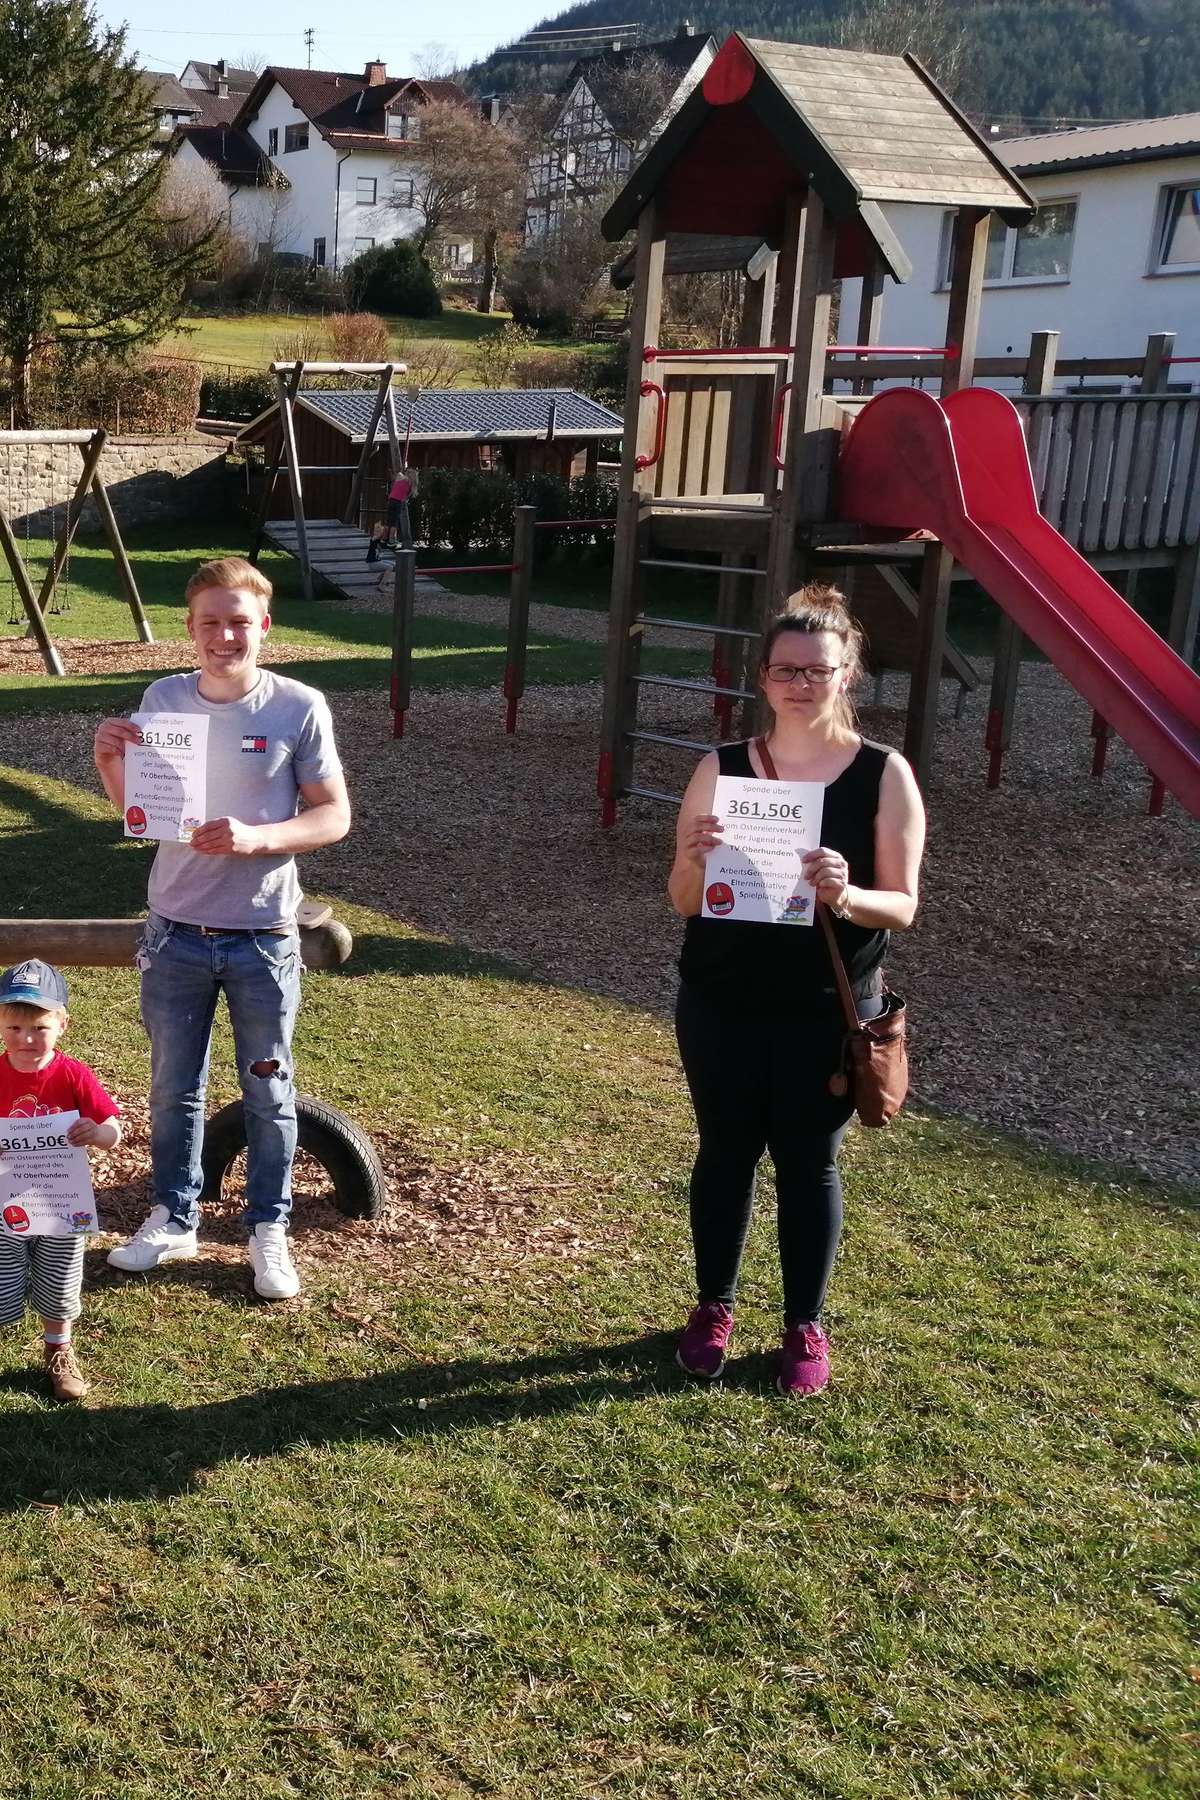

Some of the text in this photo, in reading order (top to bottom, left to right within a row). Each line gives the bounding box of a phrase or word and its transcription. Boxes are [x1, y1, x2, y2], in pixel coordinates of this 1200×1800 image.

[137, 731, 192, 747] 361,50€
[742, 785, 791, 795] Spende über
[727, 800, 803, 819] 361,50€
[740, 823, 805, 835] Ostereierverkauf
[748, 835, 775, 845] Jugend
[778, 837, 791, 845] des
[741, 846, 794, 857] Oberhundem
[761, 859, 773, 867] die
[0, 1135, 67, 1151] 361,50€
[23, 1171, 69, 1179] Oberhundem
